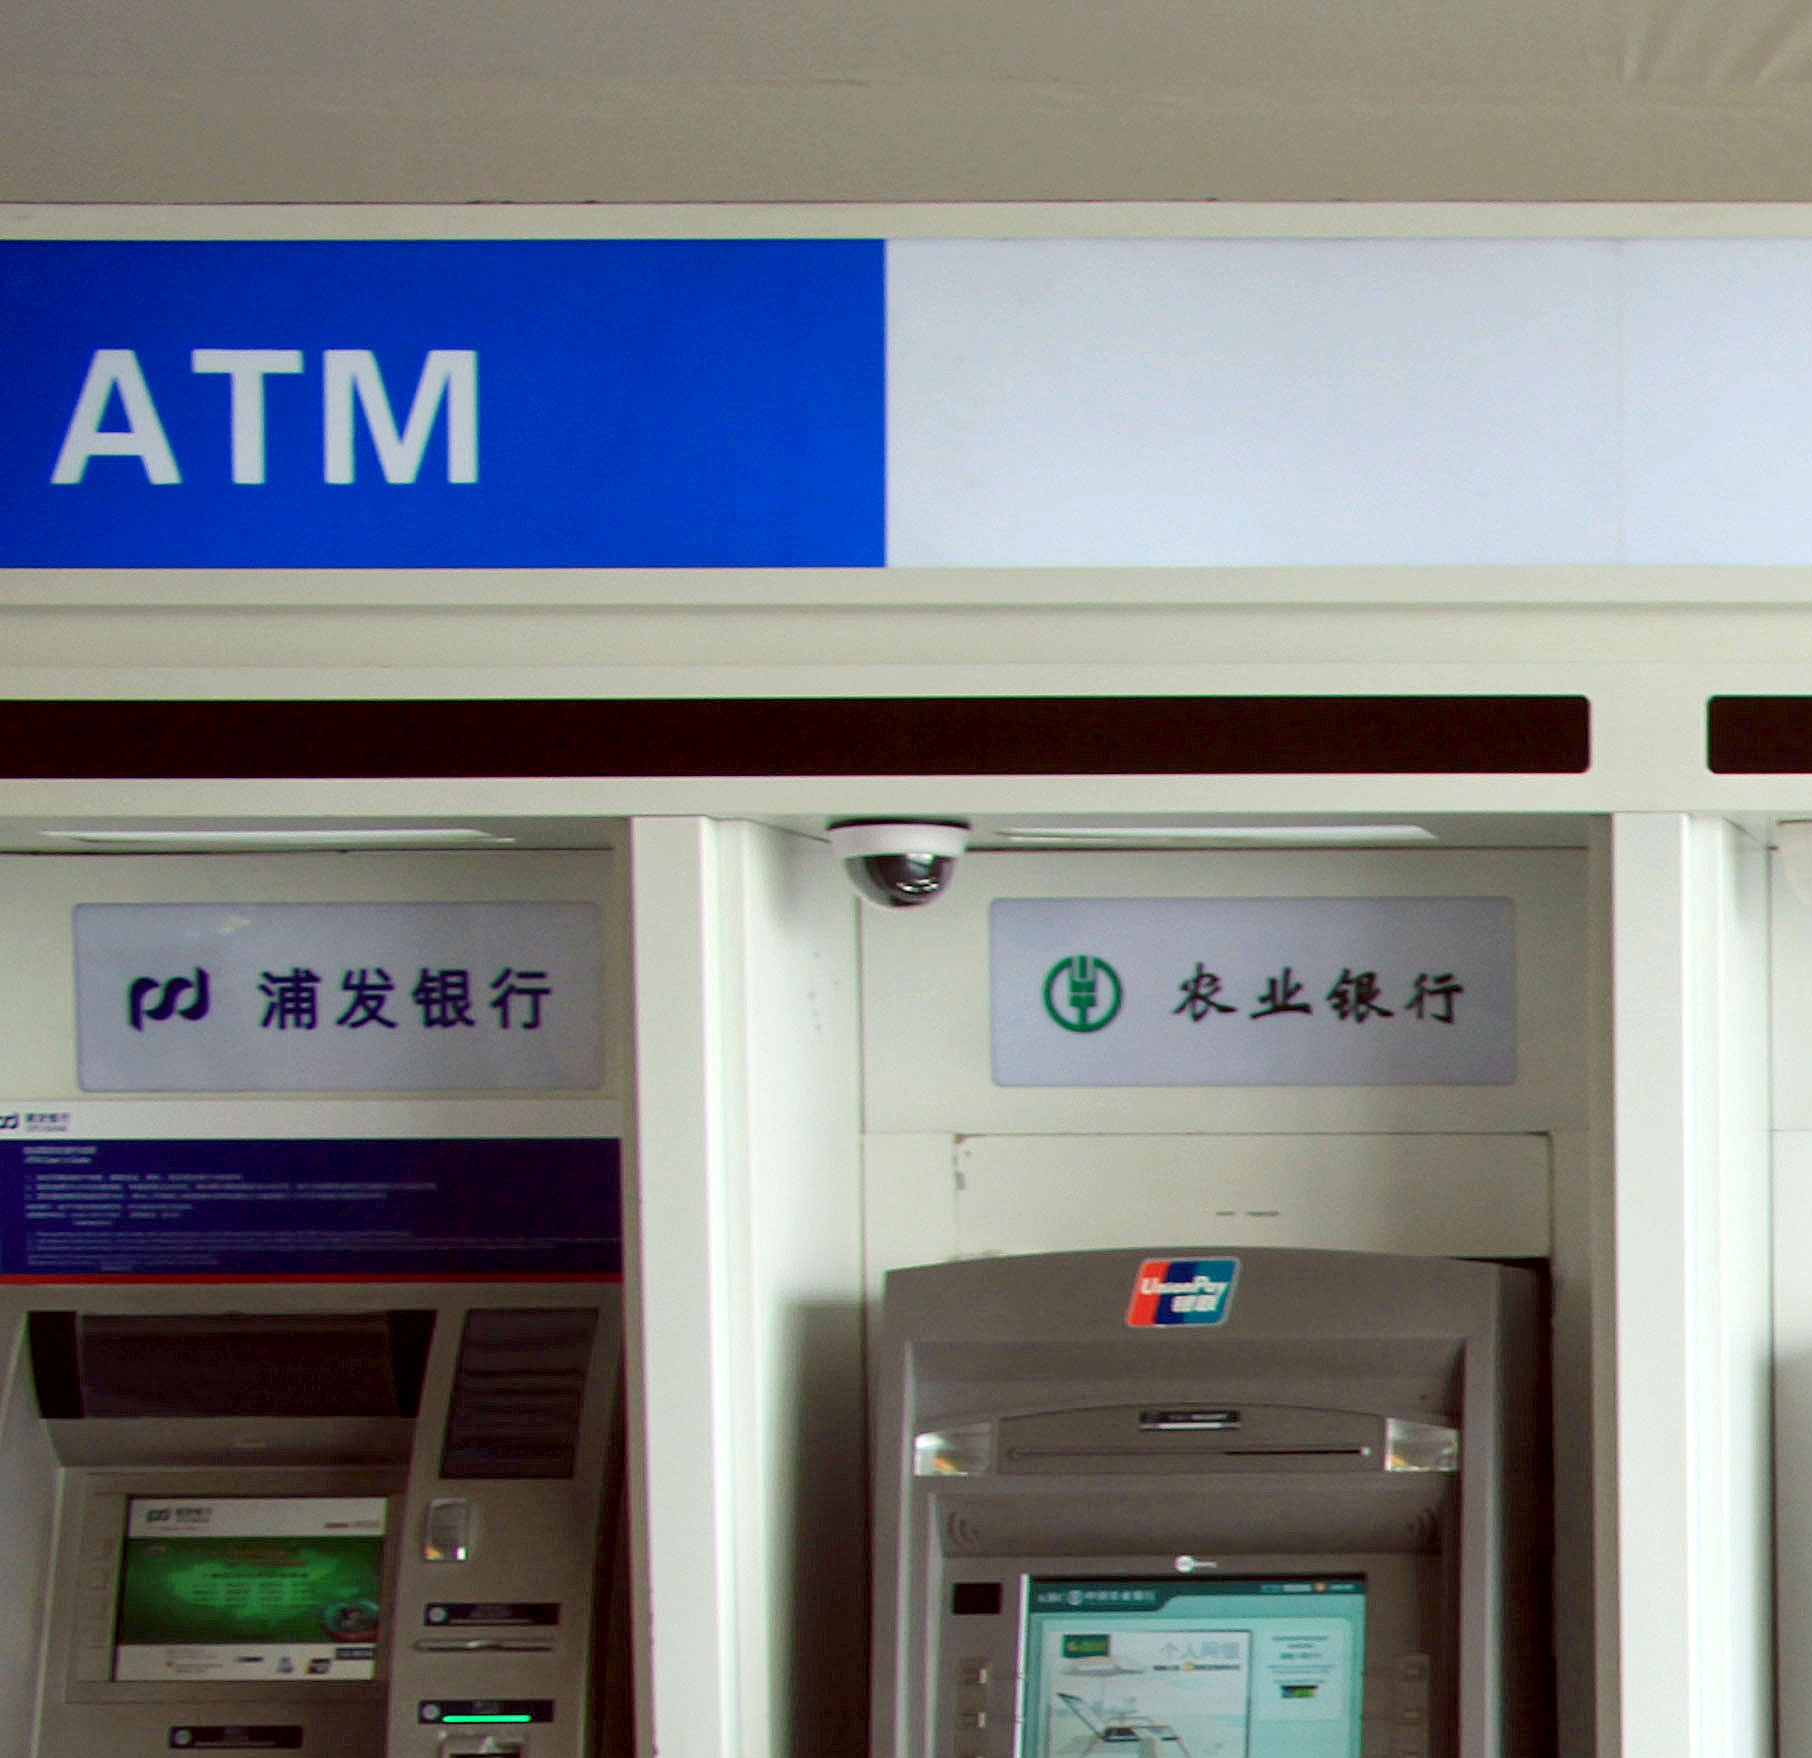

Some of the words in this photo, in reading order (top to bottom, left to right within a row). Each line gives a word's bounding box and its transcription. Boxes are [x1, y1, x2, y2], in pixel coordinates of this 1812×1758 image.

[50, 348, 480, 485] ATM
[257, 966, 554, 1031] 浦发银行
[1173, 962, 1466, 1025] 农业银行
